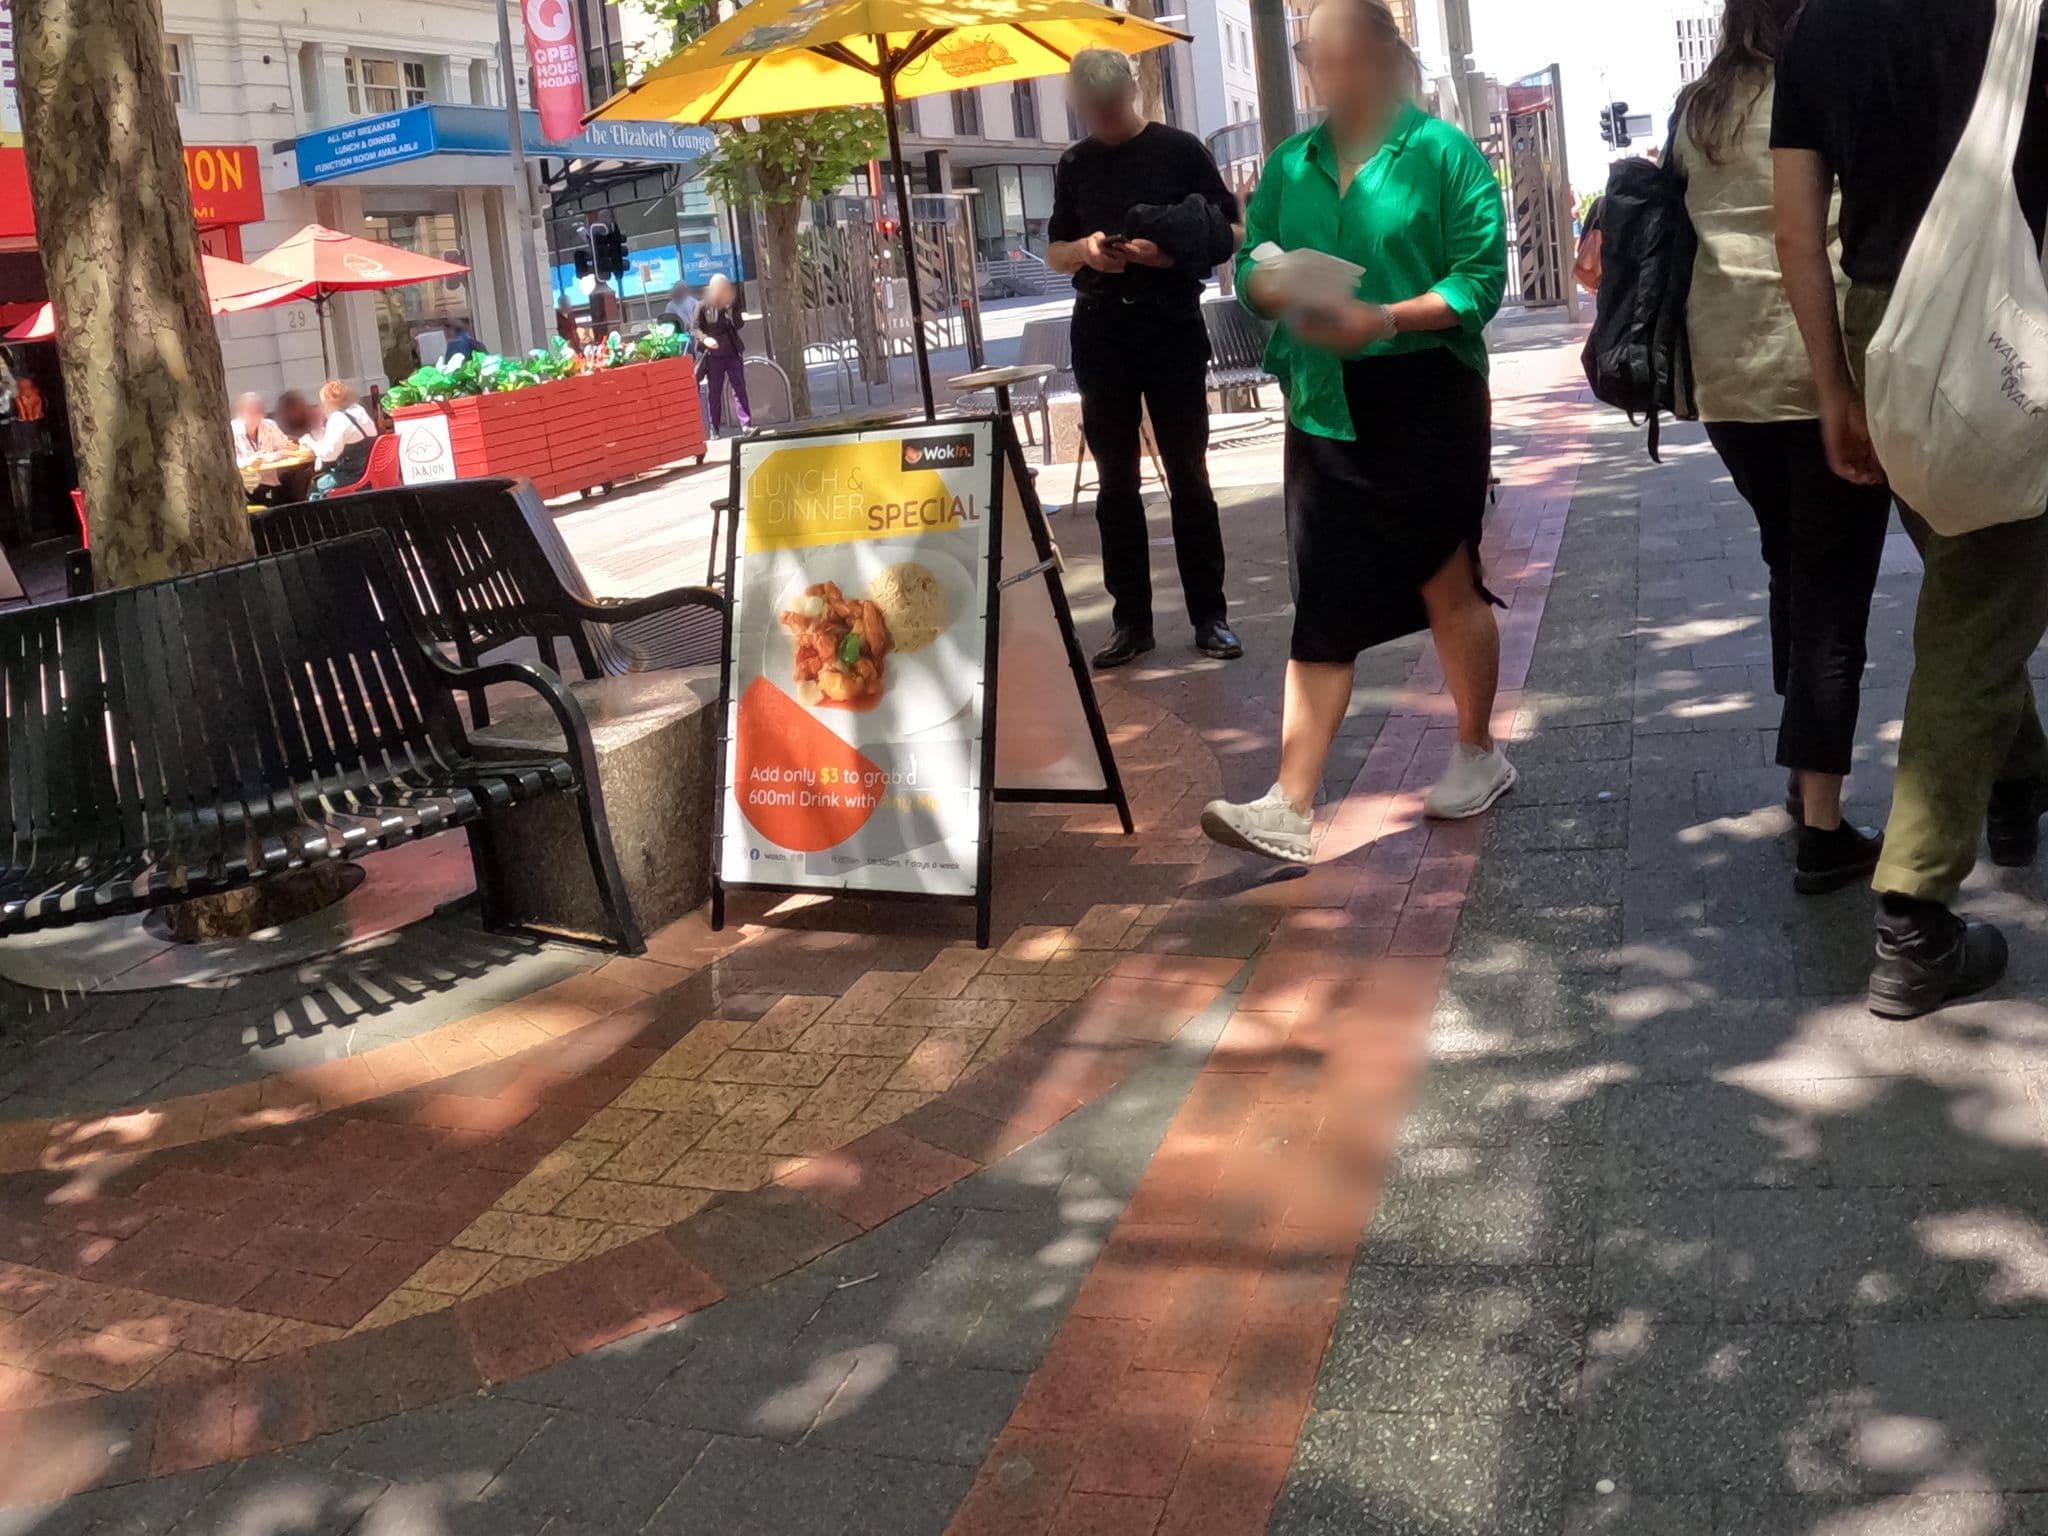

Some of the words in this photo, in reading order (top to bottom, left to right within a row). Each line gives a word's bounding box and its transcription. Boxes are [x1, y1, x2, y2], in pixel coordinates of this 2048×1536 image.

[327, 135, 340, 143] ALL
[342, 130, 356, 140] DAY
[358, 118, 400, 136] BREAKFAST
[334, 142, 360, 155] LUNCH
[361, 140, 367, 149] &
[368, 133, 397, 148] DINNER
[585, 123, 608, 146] The
[610, 125, 667, 149] Elizabeth
[668, 129, 711, 154] Lounge
[314, 157, 353, 174] FUNCTION
[353, 151, 377, 164] ROOM
[377, 142, 419, 157] AVAILABLE
[288, 310, 306, 329] 29
[1987, 331, 2032, 376] WALK
[2001, 377, 2048, 420] WALK
[752, 470, 838, 498] LUNCH
[847, 466, 864, 491] &
[768, 494, 865, 525] DINNER
[867, 494, 981, 531] SPECIAL
[750, 766, 780, 782] Add
[783, 768, 816, 786] only
[820, 767, 839, 785] $3
[843, 768, 860, 785] to
[864, 768, 901, 788] grab
[749, 789, 795, 806] 600ml
[800, 790, 840, 808] Drink
[844, 791, 877, 809] with
